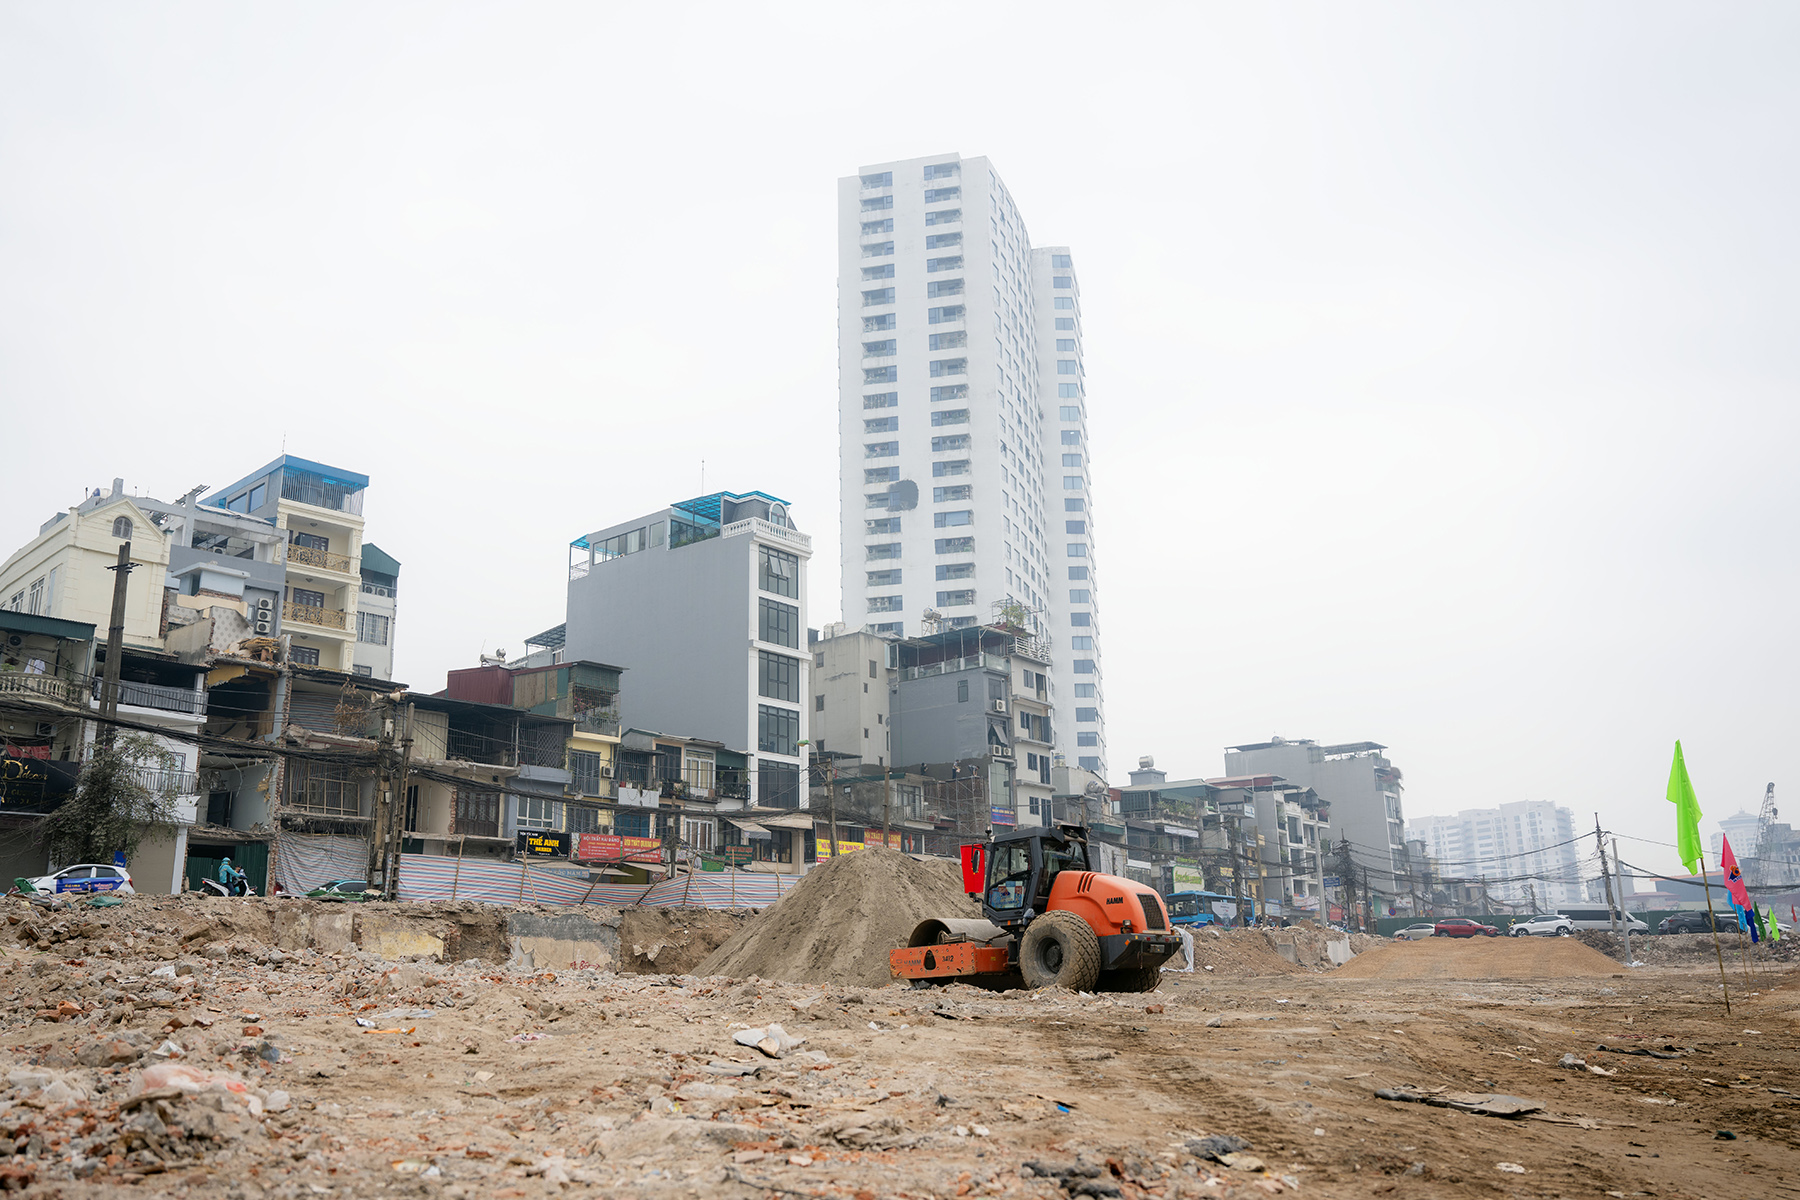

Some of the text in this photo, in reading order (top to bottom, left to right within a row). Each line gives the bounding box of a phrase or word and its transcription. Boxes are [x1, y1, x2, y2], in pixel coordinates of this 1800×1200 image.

[529, 835, 560, 847] THẾ ANH
[1106, 896, 1124, 905] HAMM
